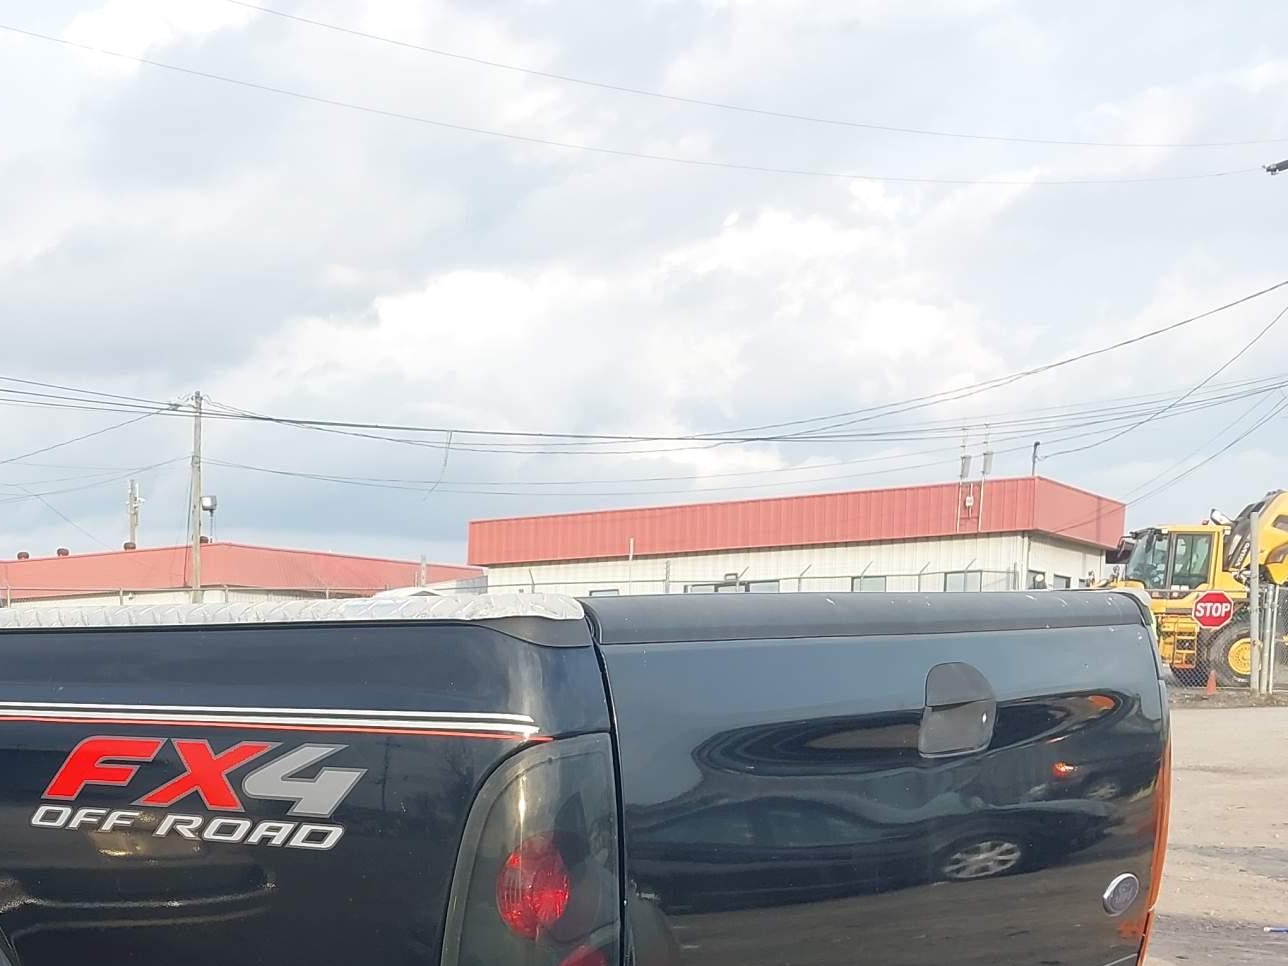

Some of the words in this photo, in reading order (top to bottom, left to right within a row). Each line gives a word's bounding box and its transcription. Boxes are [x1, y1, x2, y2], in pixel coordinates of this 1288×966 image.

[1195, 602, 1230, 617] STOP
[41, 735, 368, 817] FX4
[29, 804, 141, 833] OFF
[152, 812, 345, 851] ROAD
